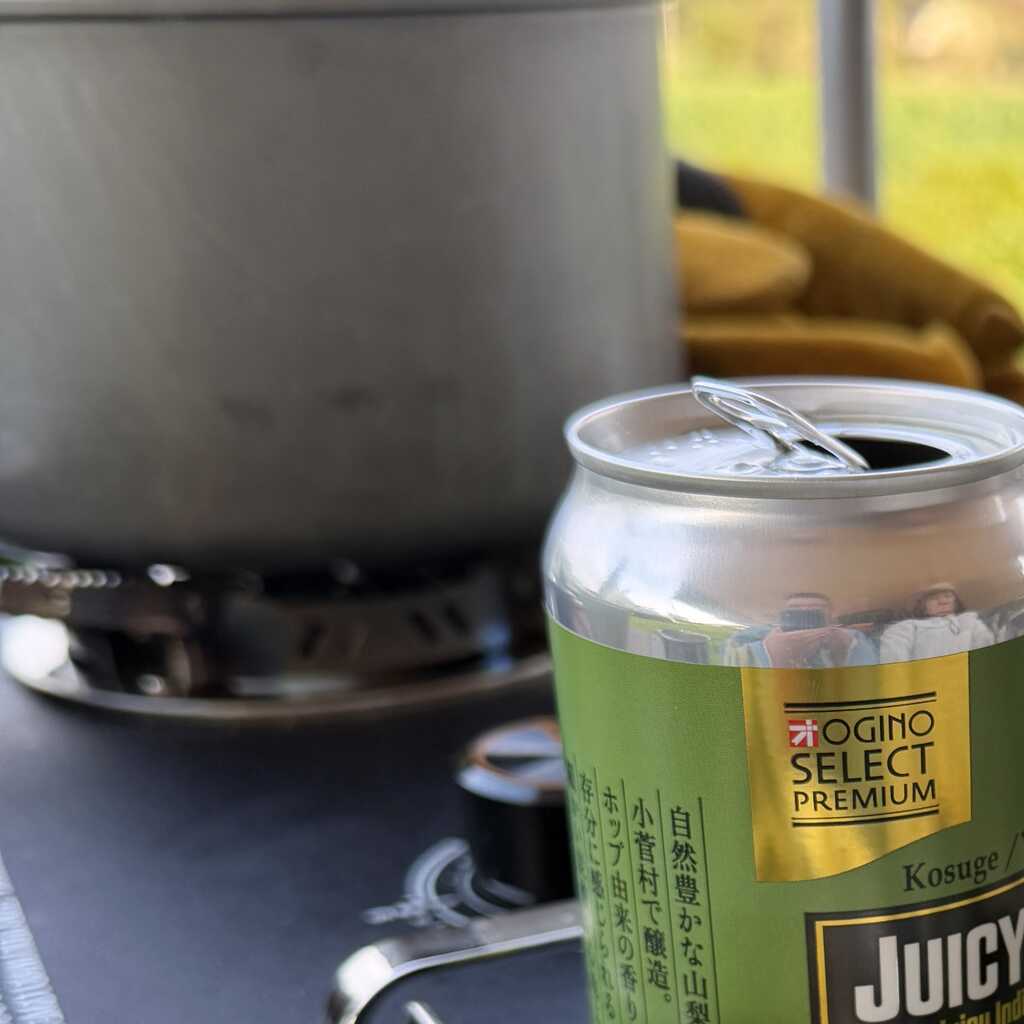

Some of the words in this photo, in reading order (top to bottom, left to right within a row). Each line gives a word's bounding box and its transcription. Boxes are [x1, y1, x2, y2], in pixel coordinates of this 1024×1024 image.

[823, 710, 935, 745] OGINO
[790, 741, 935, 785] SELECT
[794, 779, 936, 812] PREMIUM
[903, 851, 999, 892] Kosuge
[632, 797, 671, 1003] 小菅村で醸造。
